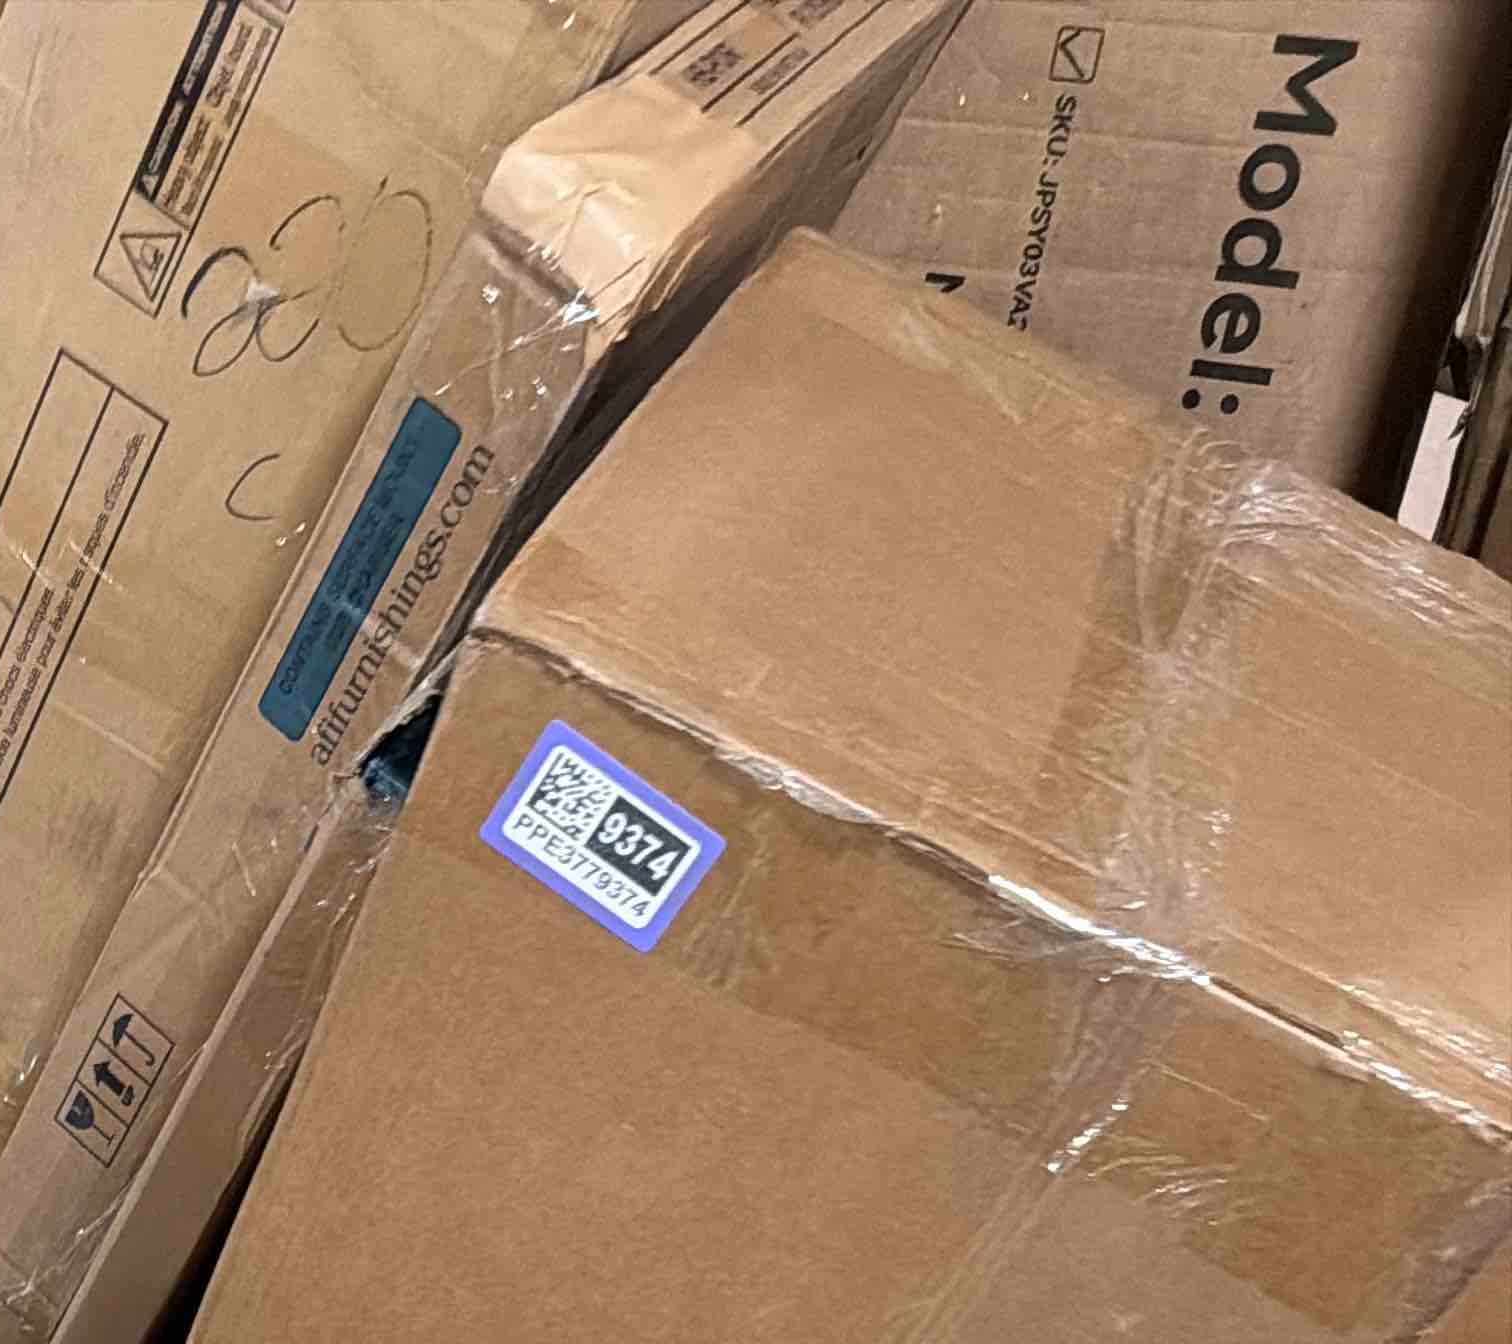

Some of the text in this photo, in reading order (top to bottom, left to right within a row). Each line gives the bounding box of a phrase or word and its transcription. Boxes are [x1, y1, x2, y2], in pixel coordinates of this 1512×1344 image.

[1043, 94, 1076, 166] SKU:
[1182, 34, 1359, 415] Model:
[311, 445, 494, 765] afifurnishings.com
[511, 812, 651, 917] PPE3779374
[597, 812, 681, 881] 9374
